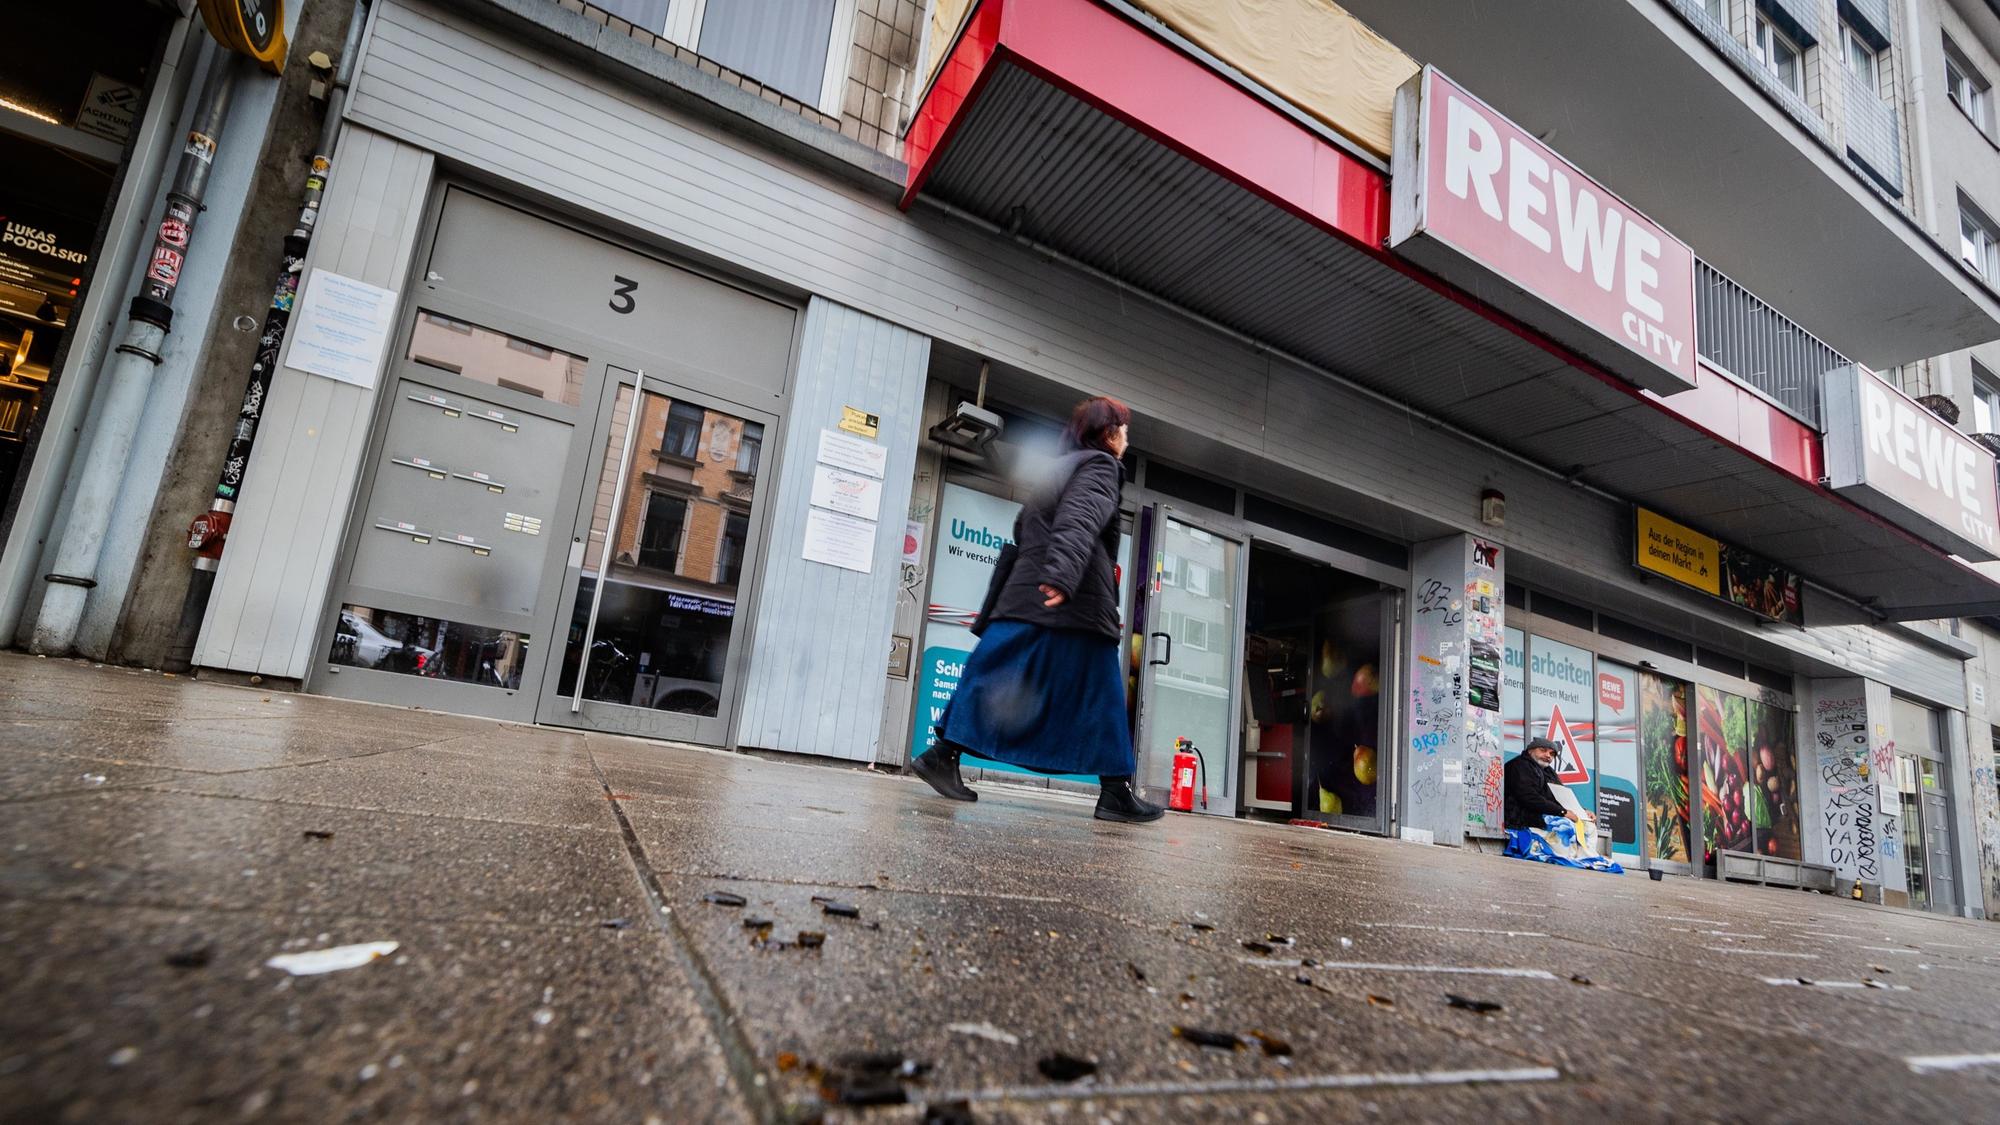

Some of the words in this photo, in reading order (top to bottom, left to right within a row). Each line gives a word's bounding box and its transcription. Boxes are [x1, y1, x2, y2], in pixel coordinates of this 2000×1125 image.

[1445, 95, 1664, 323] REWE
[6, 221, 56, 244] LUKAS
[609, 274, 638, 314] 3
[1622, 311, 1683, 366] CITY
[1866, 381, 1982, 516] REWE
[951, 518, 1013, 551] Umba
[1648, 527, 1662, 543] Aus
[1663, 534, 1675, 547] der
[1676, 539, 1697, 558] Region
[1698, 548, 1705, 560] in
[1961, 511, 1993, 546] CITY
[948, 545, 964, 557] Wir
[1649, 544, 1671, 564] deinen
[1672, 553, 1692, 571] Markt
[933, 678, 958, 690] Samst
[935, 660, 966, 678] Schl
[1531, 652, 1592, 687] arbeiten
[932, 690, 951, 700] nach
[1531, 684, 1558, 699] unseren
[1559, 690, 1579, 704] Markt!
[1602, 679, 1621, 693] REWE
